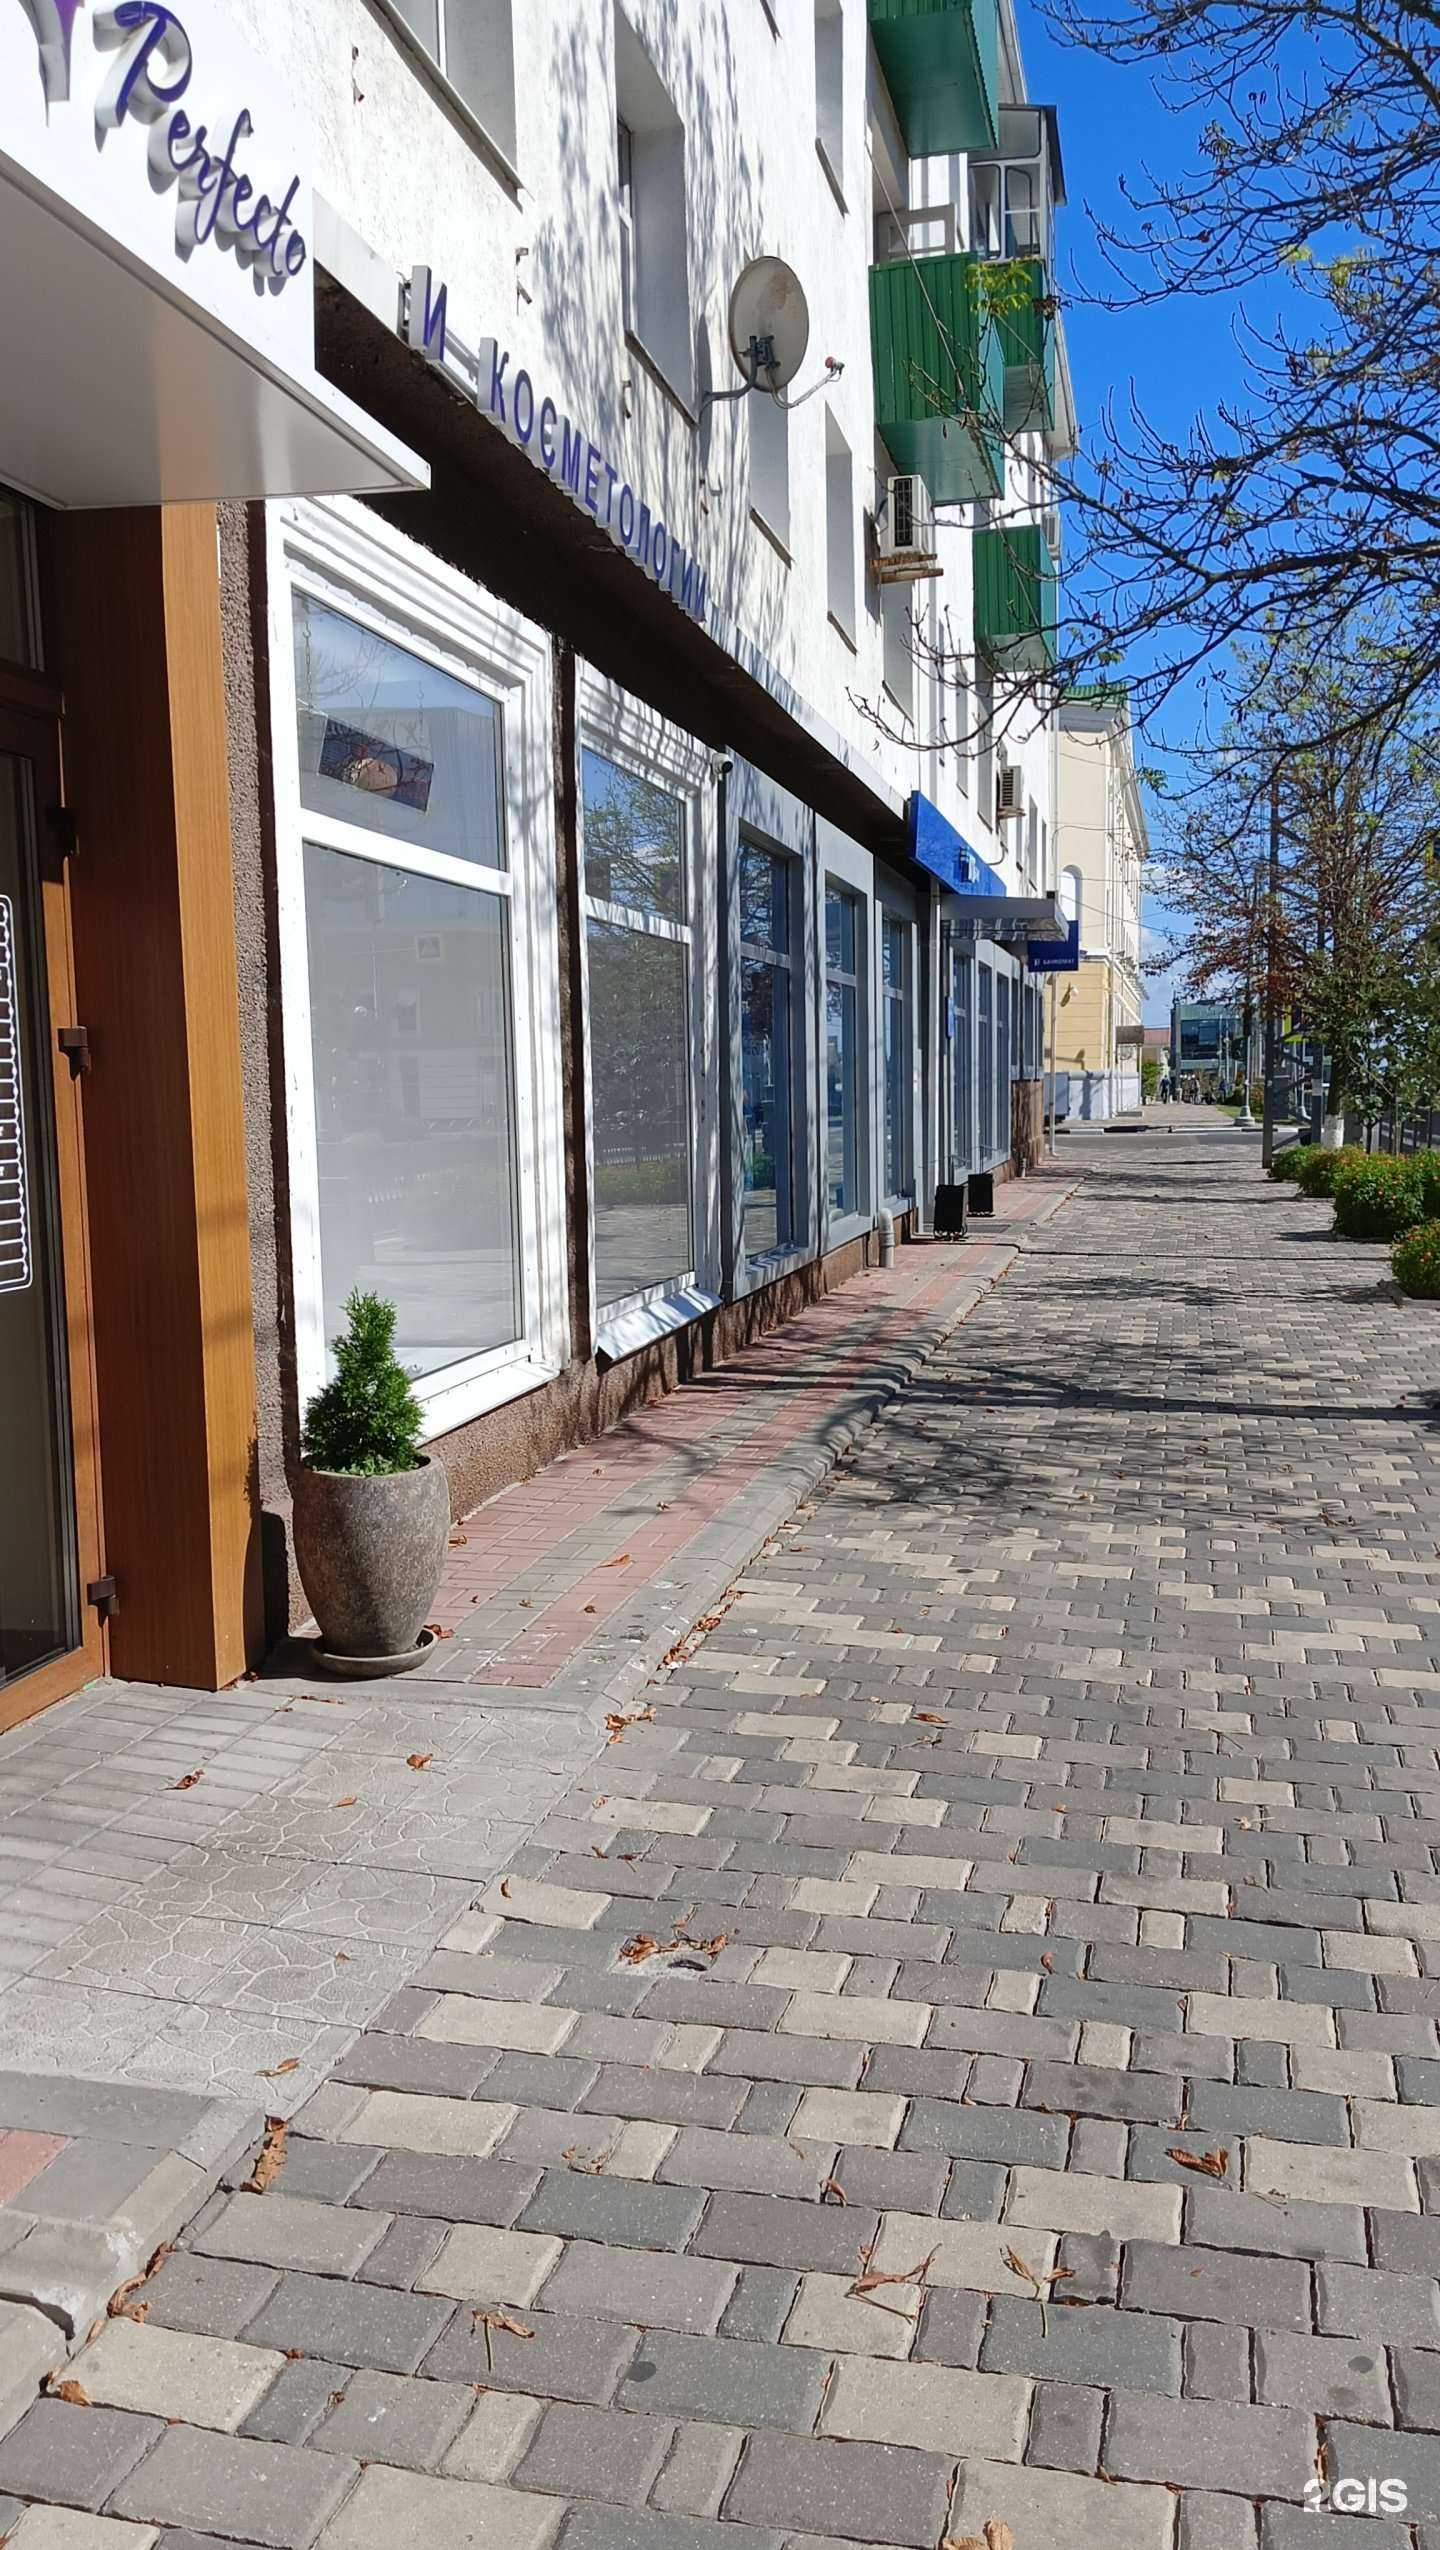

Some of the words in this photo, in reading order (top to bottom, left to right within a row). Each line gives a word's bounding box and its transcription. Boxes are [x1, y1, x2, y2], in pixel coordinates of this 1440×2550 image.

[106, 0, 306, 278] Perfecto
[415, 266, 447, 362] И
[482, 338, 707, 621] КОСМЕТОЛОГИИ
